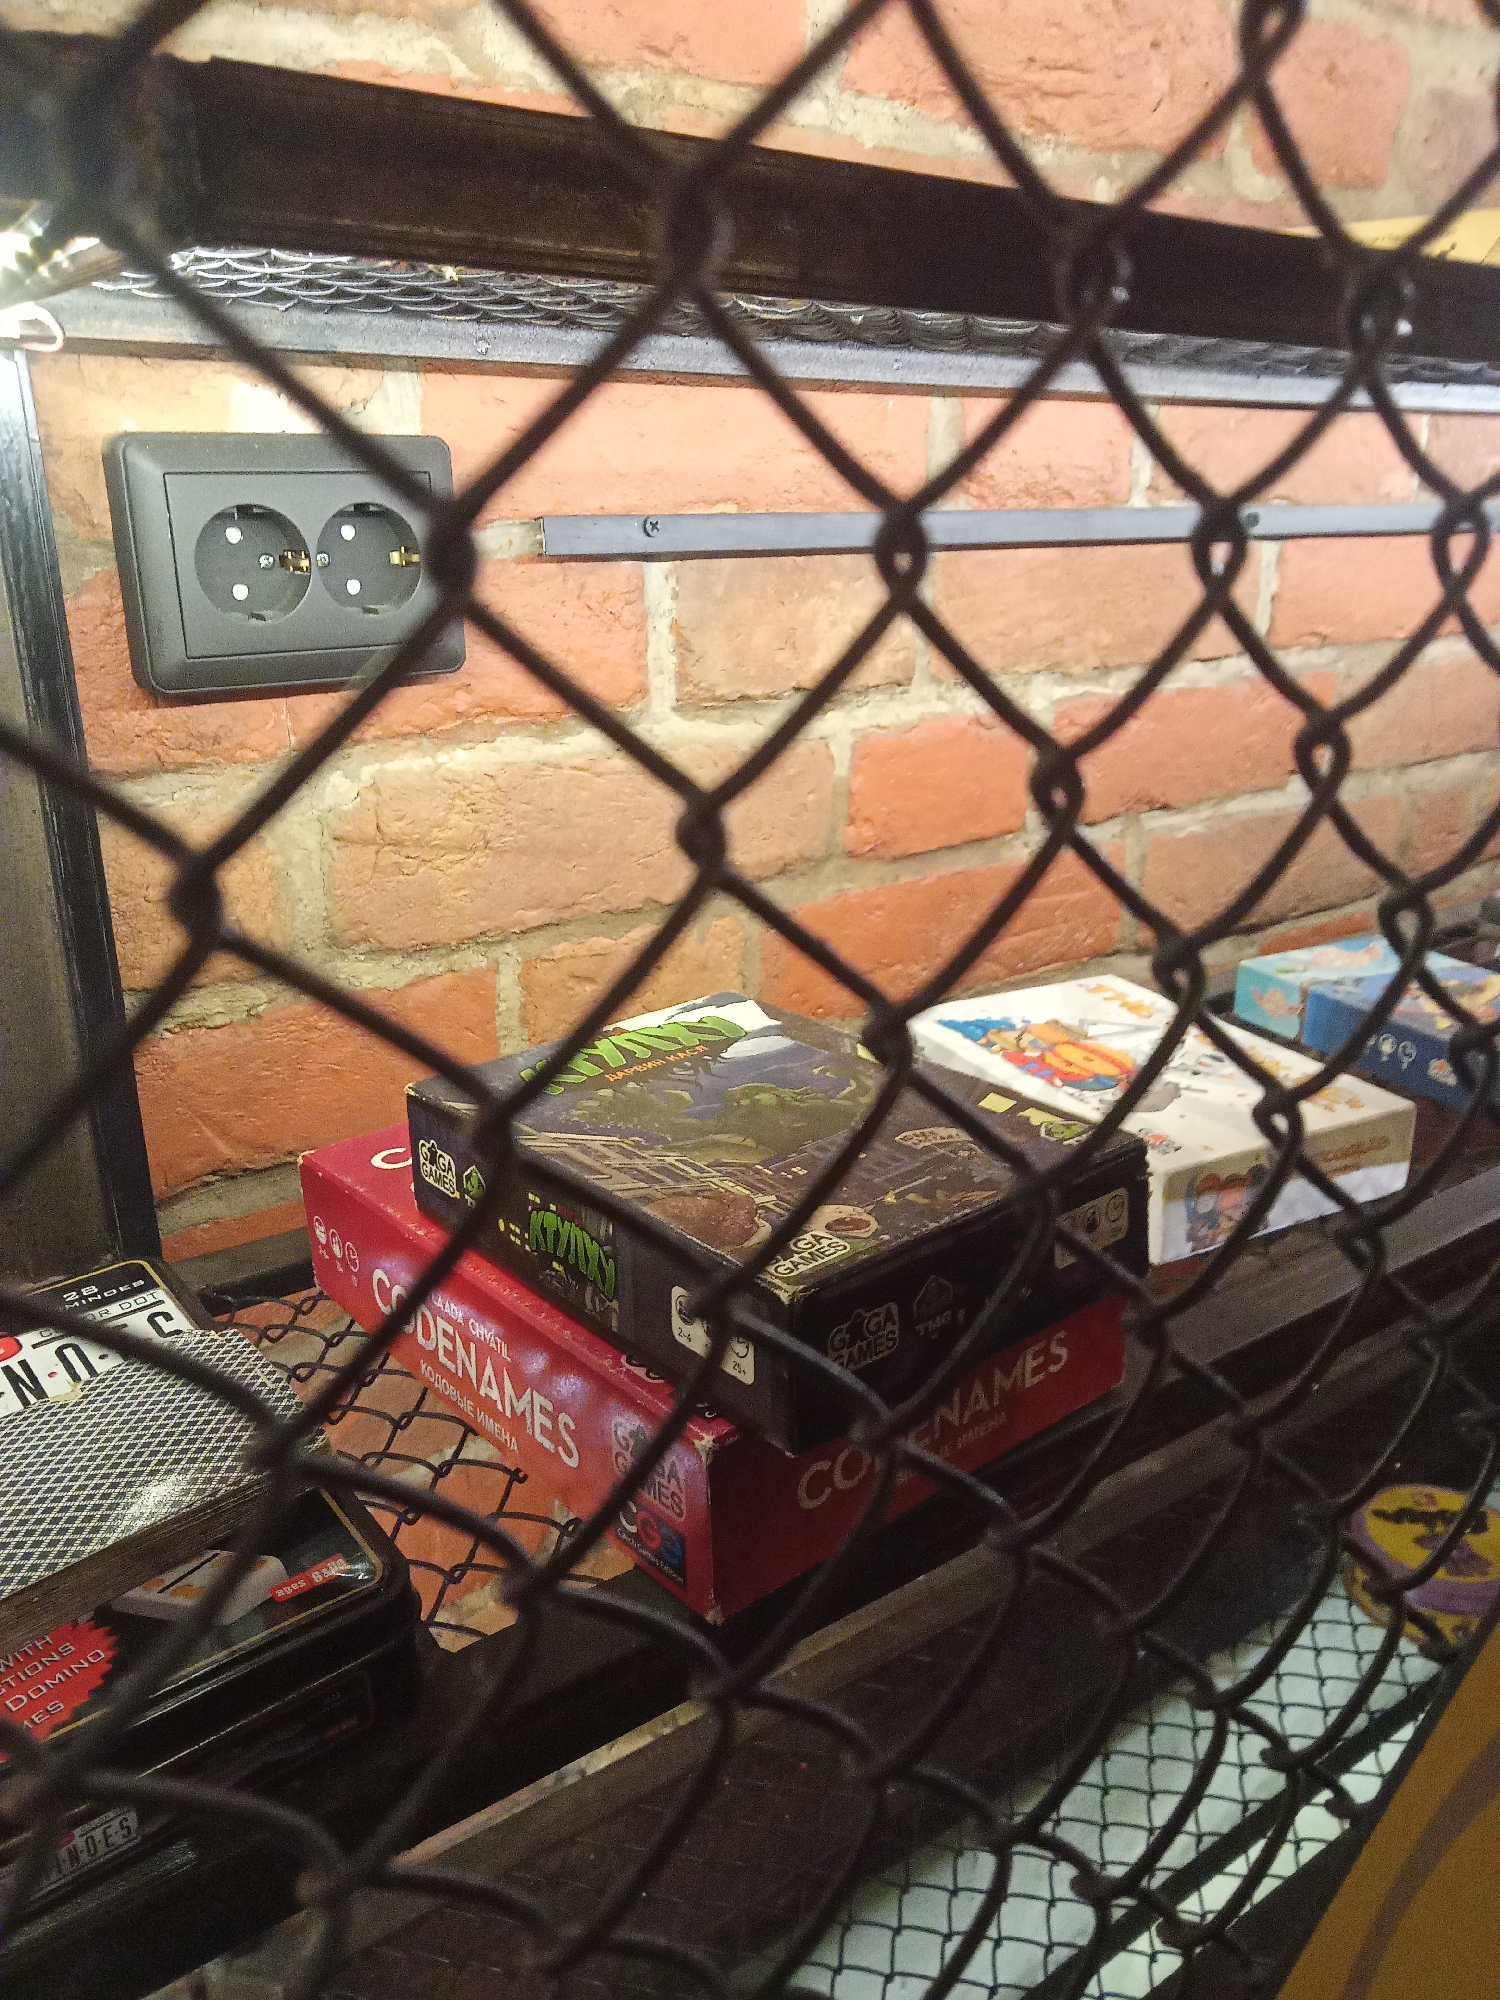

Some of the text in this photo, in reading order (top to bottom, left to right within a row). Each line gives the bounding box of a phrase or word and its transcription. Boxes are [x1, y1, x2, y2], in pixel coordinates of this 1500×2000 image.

[421, 1162, 456, 1195] GAMES
[529, 1210, 615, 1300] КТУЛХУ
[774, 1241, 848, 1276] GAMES
[62, 1285, 99, 1302] 28
[118, 1290, 158, 1312] DOT
[431, 1290, 465, 1327] LAADA
[831, 1330, 898, 1369] GAMES
[420, 1358, 520, 1454] КОДОВЫЕ ИМЕНА
[797, 1331, 1069, 1510] COENAMES
[275, 1579, 307, 1598] ages
[5, 1649, 106, 1712] DOMINO
